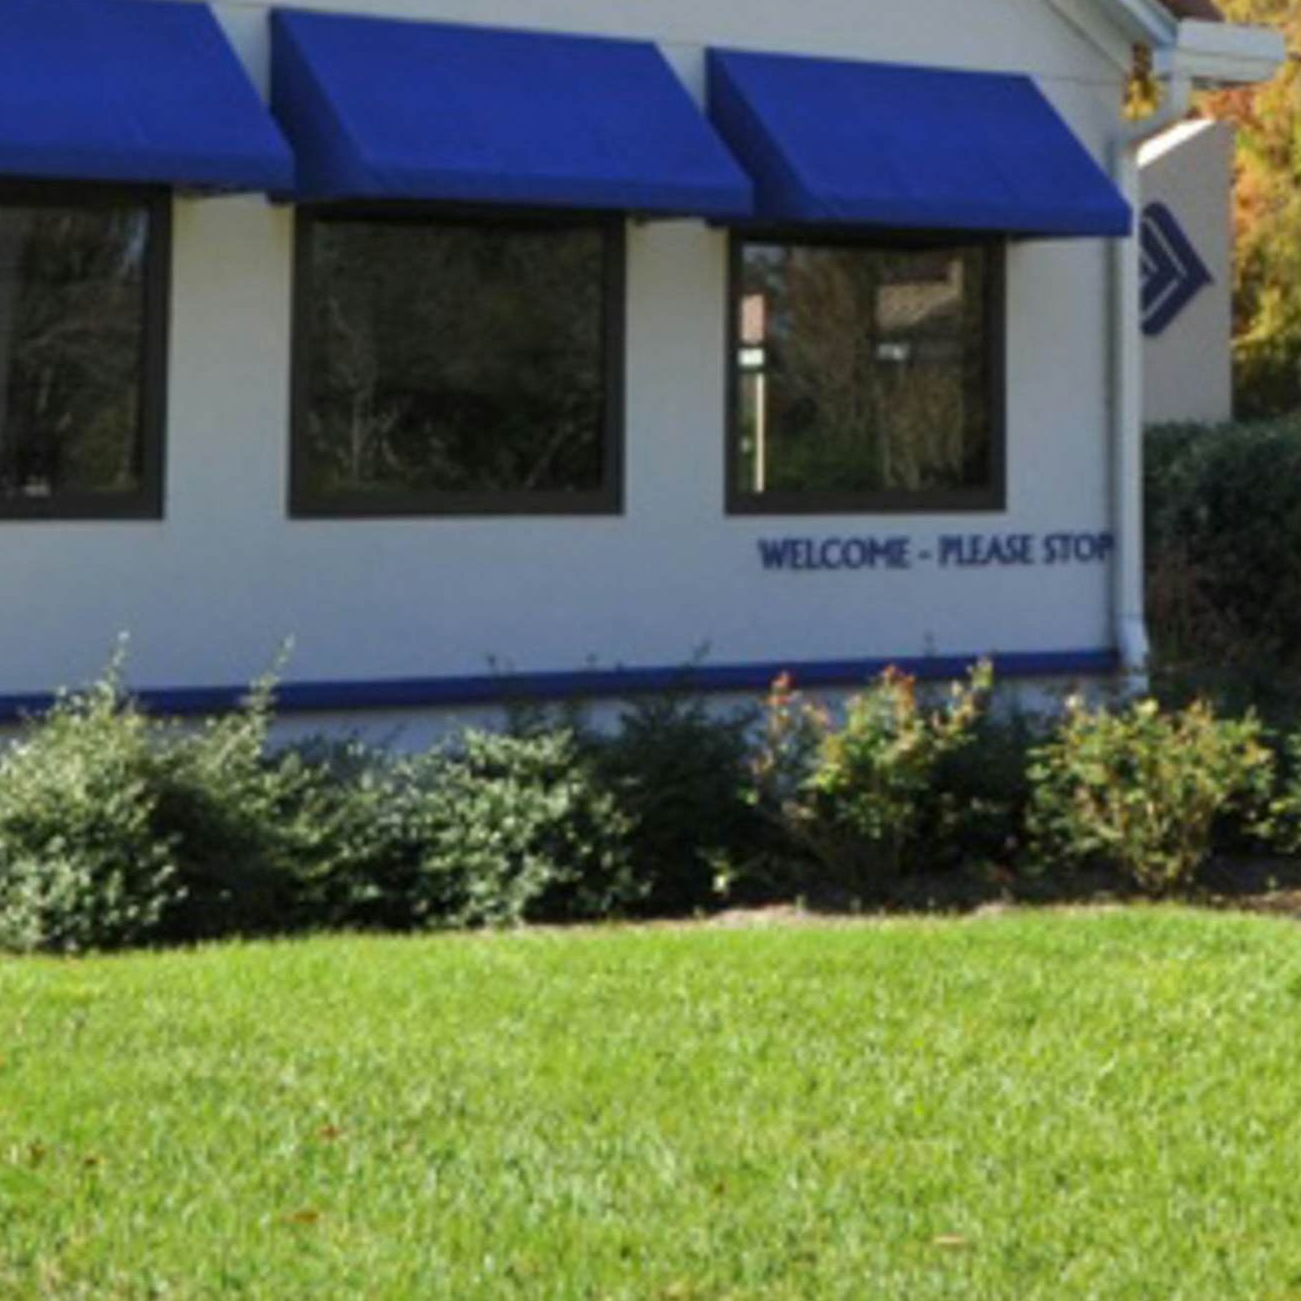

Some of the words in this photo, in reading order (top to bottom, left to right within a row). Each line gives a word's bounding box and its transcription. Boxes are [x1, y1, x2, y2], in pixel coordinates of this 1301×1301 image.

[758, 534, 911, 570] WELCOME
[938, 534, 1034, 566] PLEASE
[1043, 532, 1115, 563] STOP
